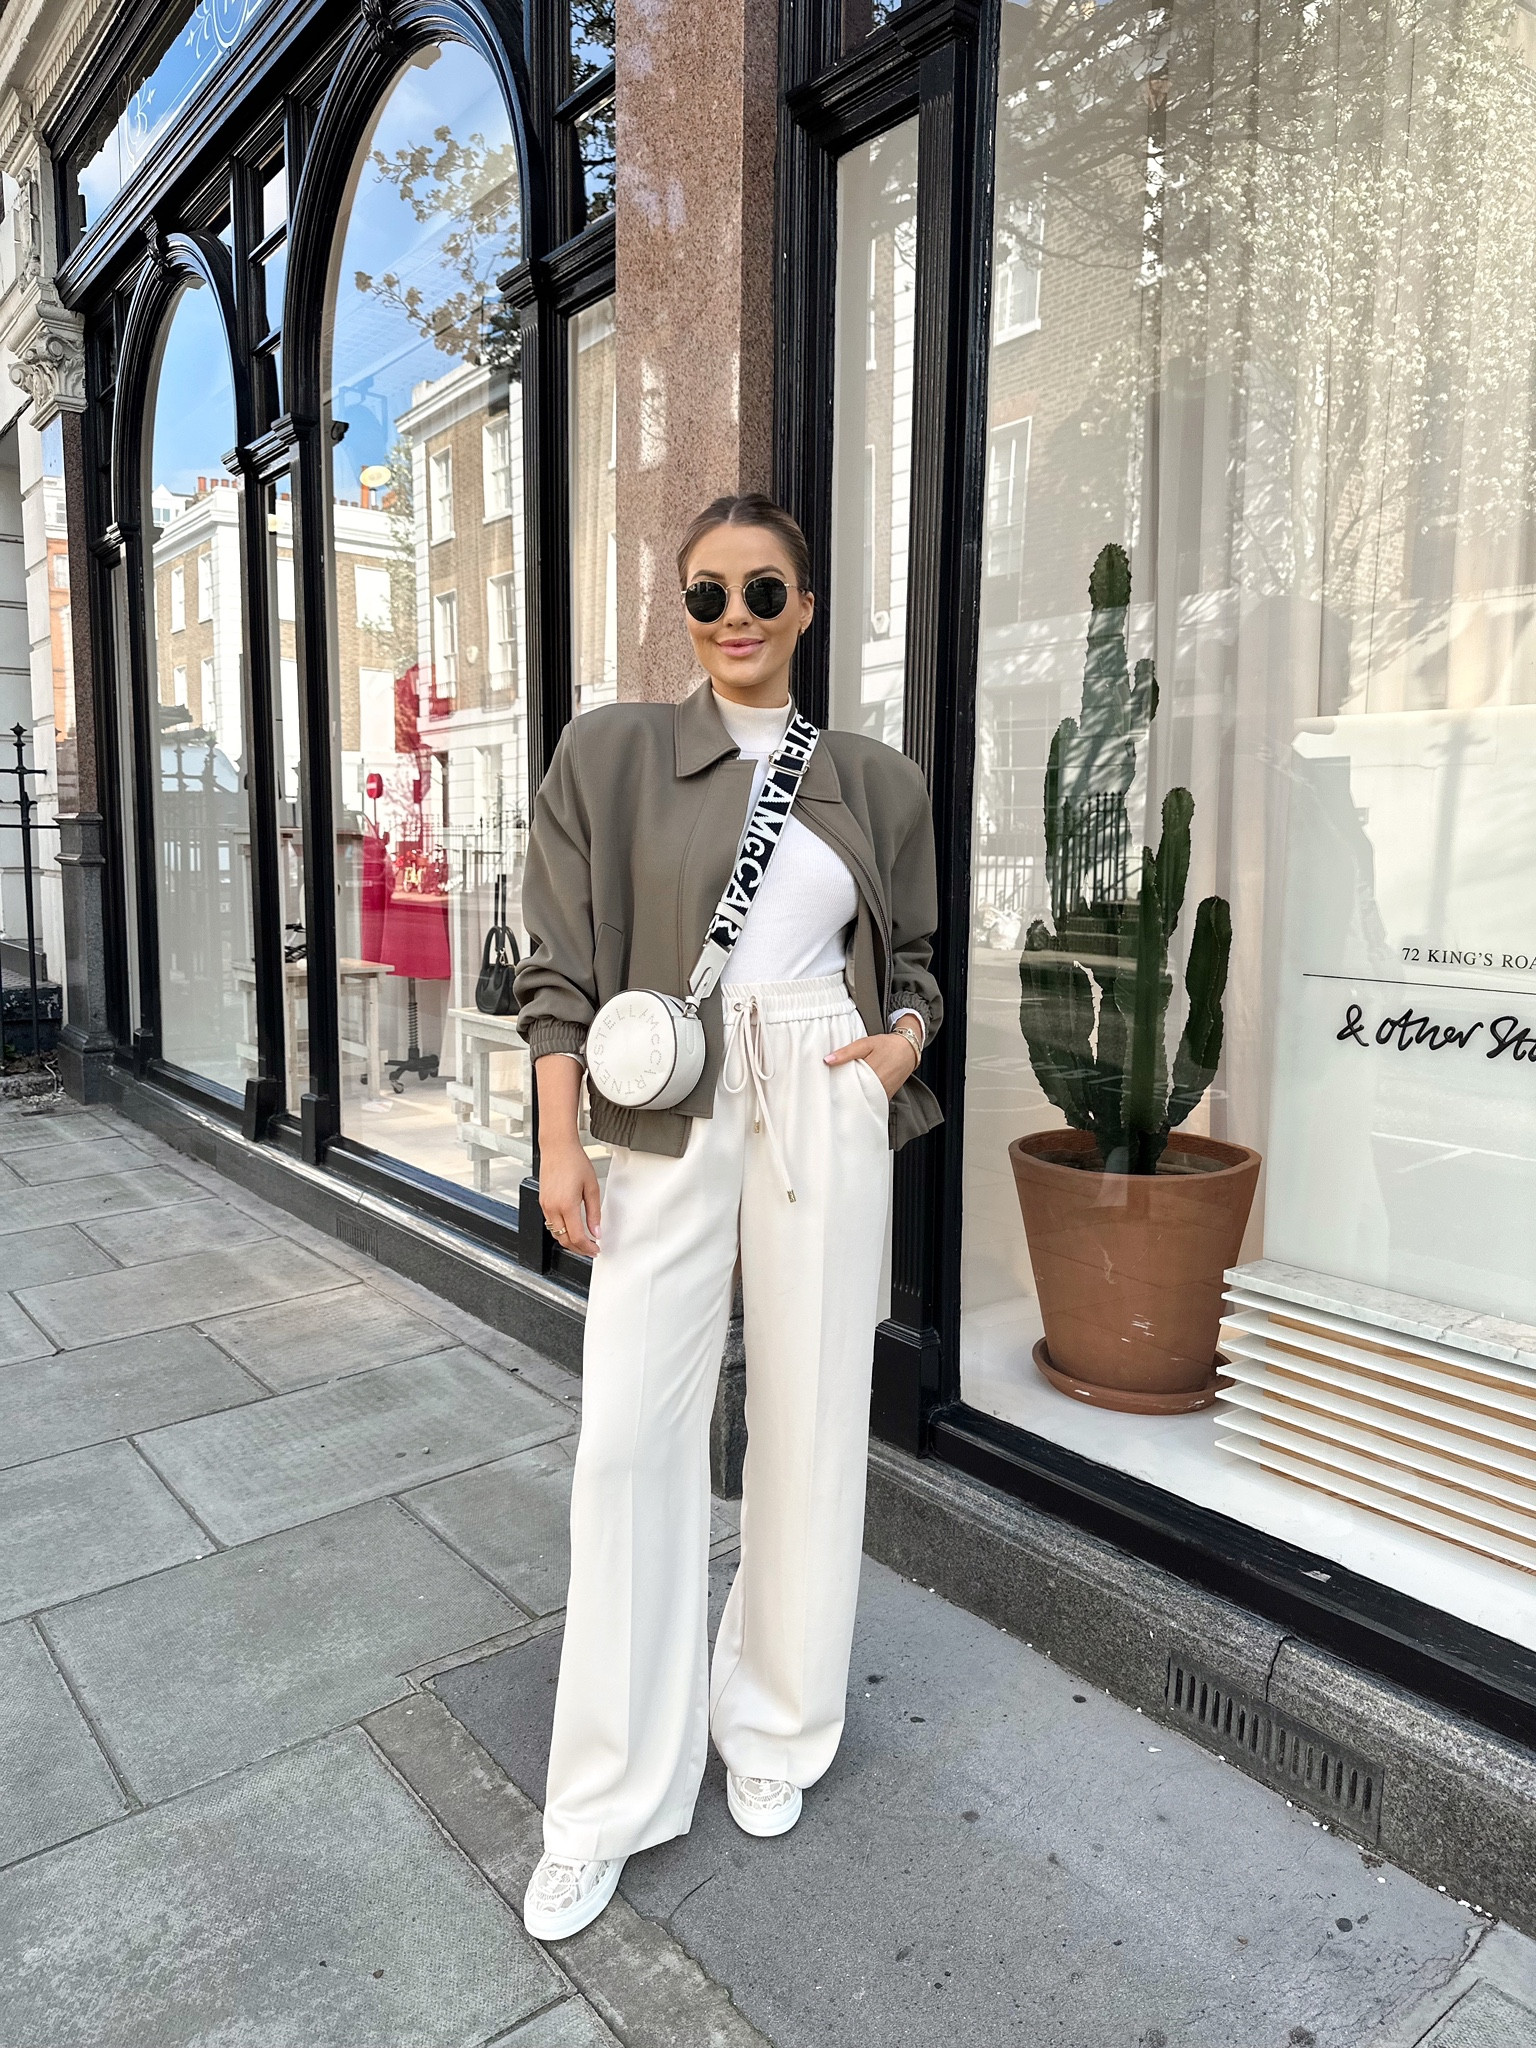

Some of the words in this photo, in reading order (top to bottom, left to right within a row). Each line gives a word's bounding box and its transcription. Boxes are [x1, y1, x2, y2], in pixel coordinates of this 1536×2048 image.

[1402, 948, 1420, 961] 72
[1428, 949, 1493, 967] KING'S
[1336, 1003, 1369, 1047] &
[1375, 1008, 1485, 1052] other
